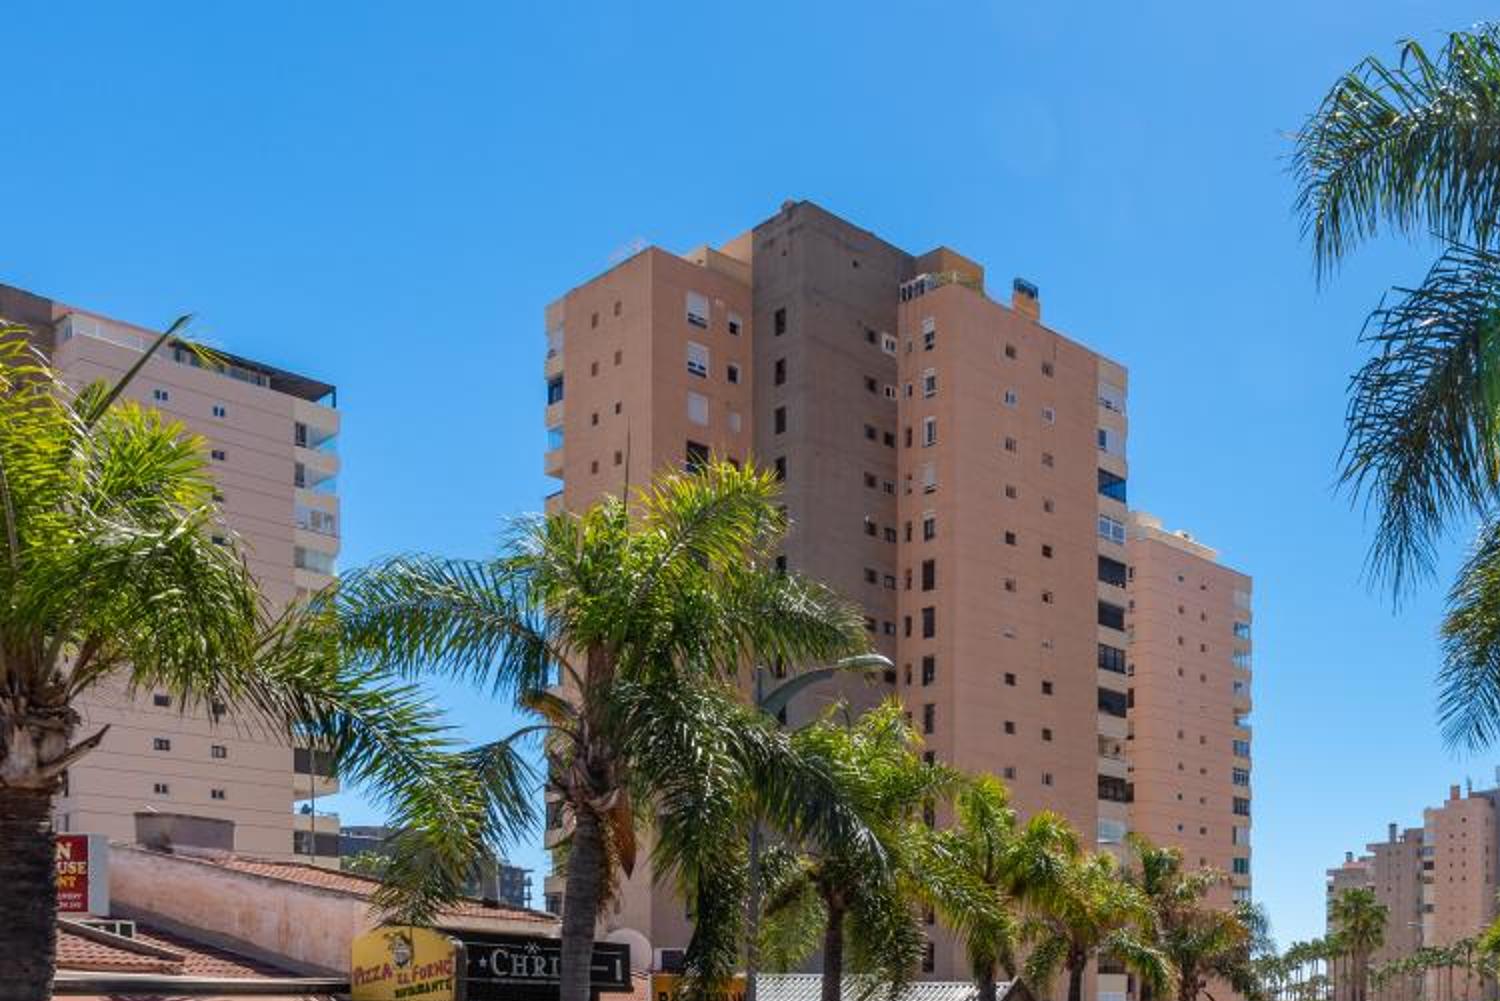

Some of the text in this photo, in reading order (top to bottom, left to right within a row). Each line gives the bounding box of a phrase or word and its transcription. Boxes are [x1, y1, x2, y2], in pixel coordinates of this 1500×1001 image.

[353, 963, 393, 987] PIZZA
[412, 960, 453, 982] FORNO
[490, 948, 561, 978] CHRI
